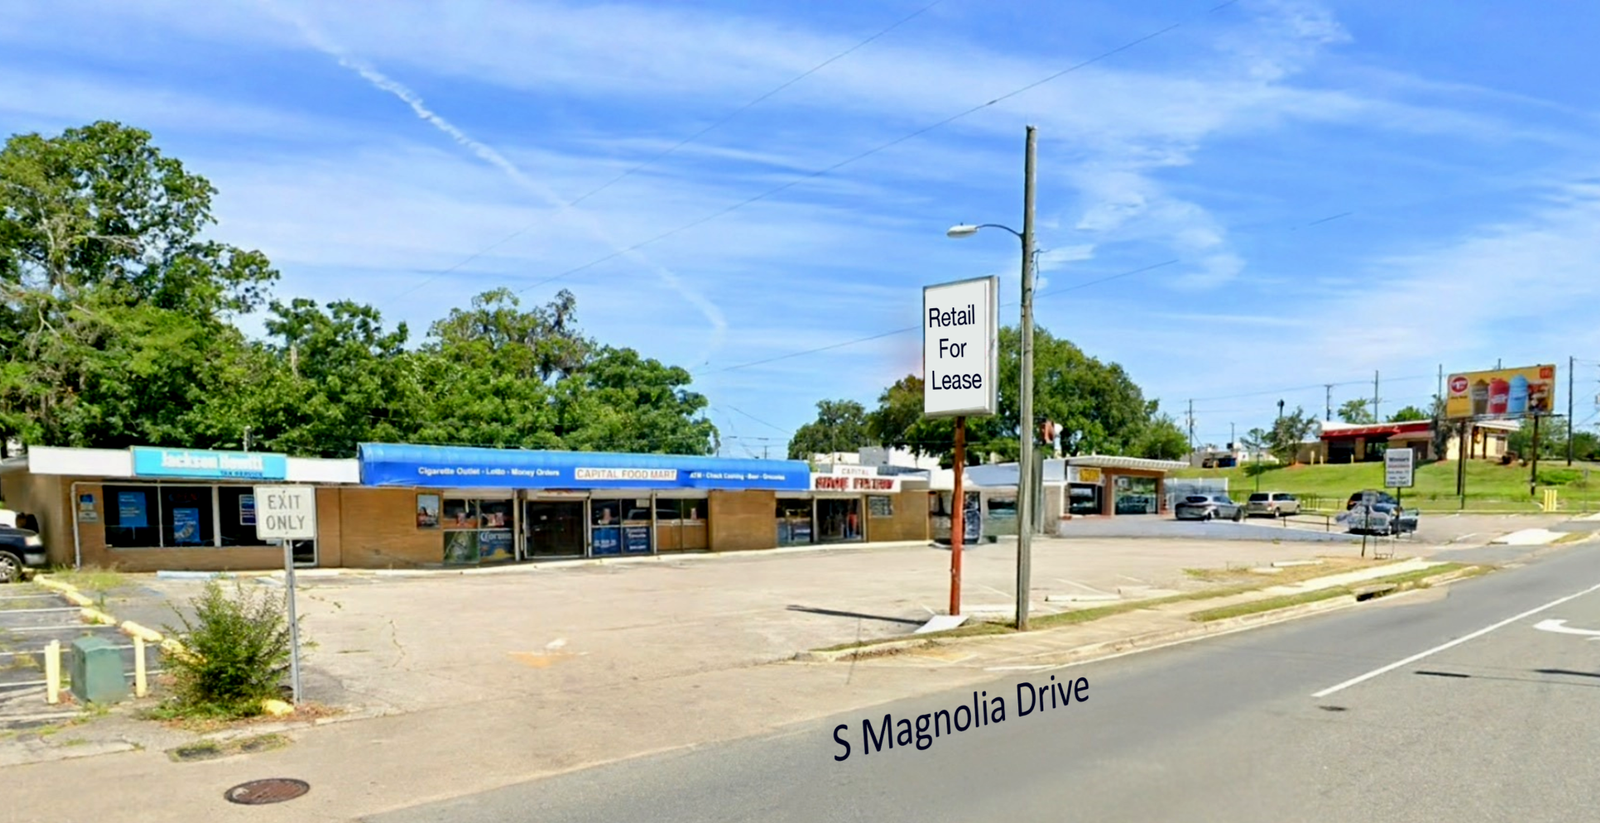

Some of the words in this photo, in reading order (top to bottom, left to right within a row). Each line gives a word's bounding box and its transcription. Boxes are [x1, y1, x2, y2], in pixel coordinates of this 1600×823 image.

[929, 304, 975, 328] Retail
[939, 338, 967, 358] For
[932, 370, 982, 390] Lease
[418, 466, 455, 476] Cigarette
[456, 467, 480, 475] Outlet
[486, 467, 506, 475] Lotto
[511, 468, 535, 477] Money
[536, 468, 560, 476] Orders
[576, 469, 618, 479] CAPITAL
[621, 469, 648, 479] FOOD
[650, 470, 676, 479] MART
[841, 468, 870, 476] CAPITAL
[267, 494, 301, 510] EXIT
[266, 515, 305, 530] ONLY
